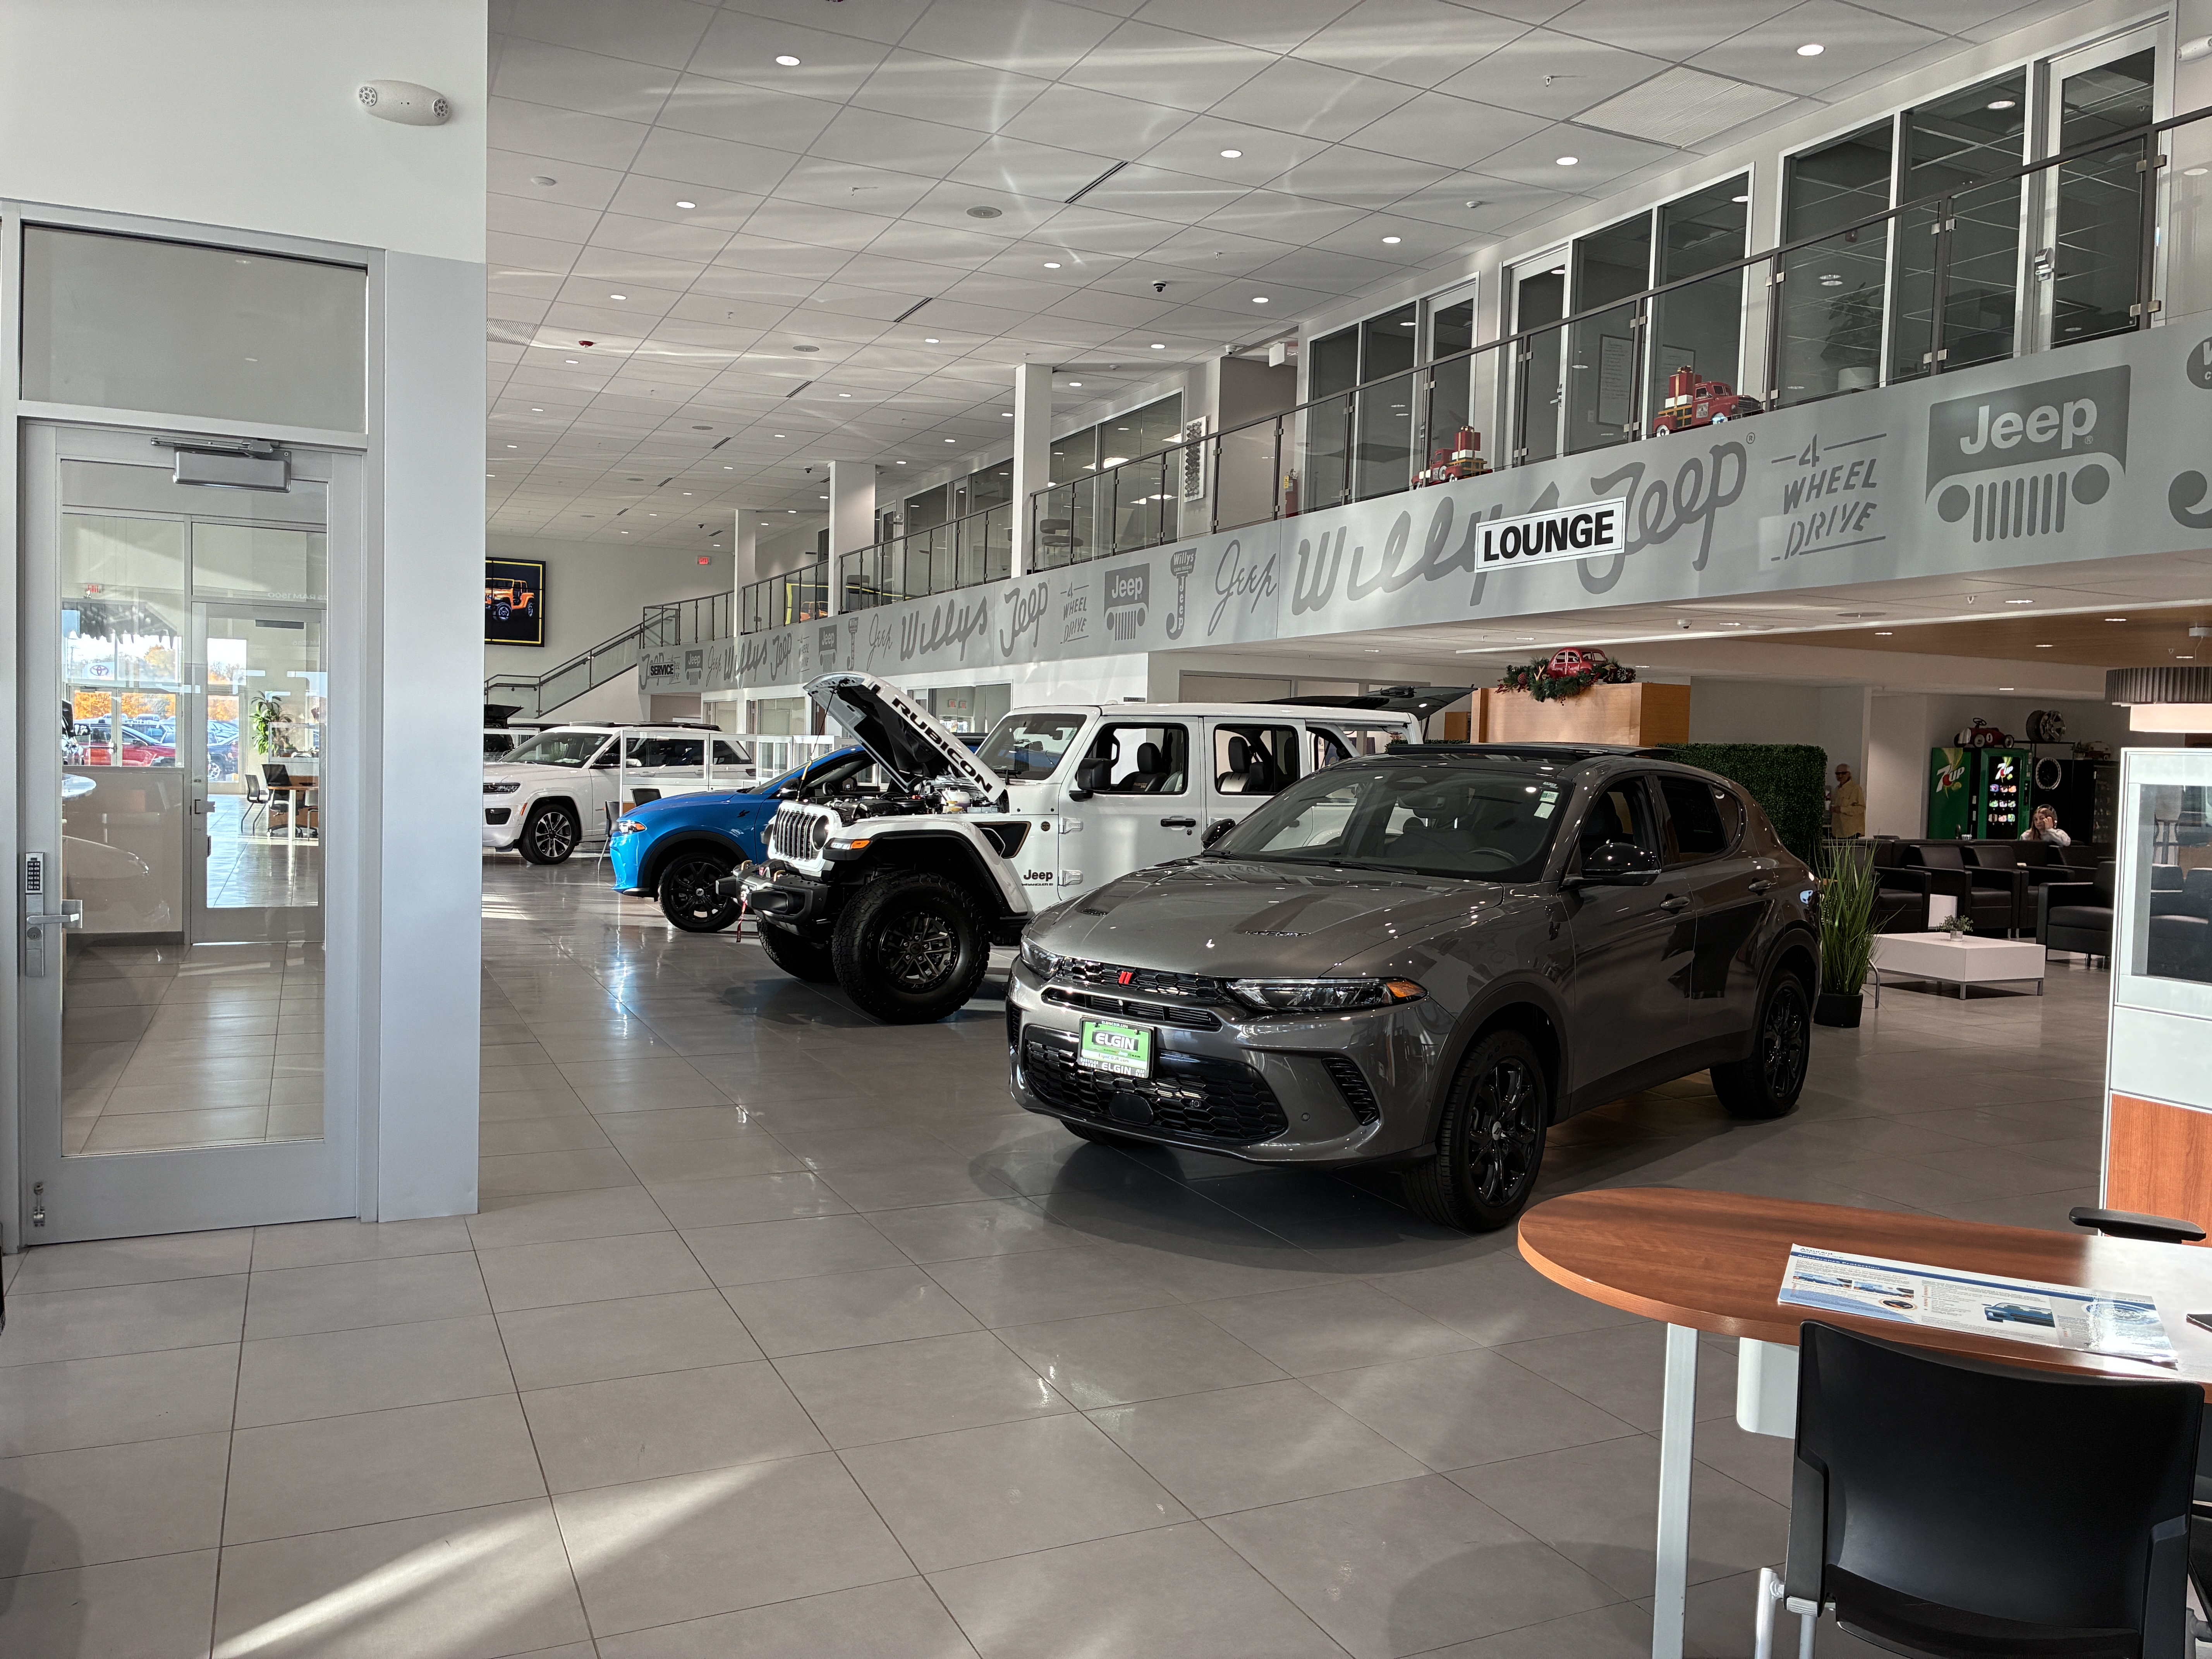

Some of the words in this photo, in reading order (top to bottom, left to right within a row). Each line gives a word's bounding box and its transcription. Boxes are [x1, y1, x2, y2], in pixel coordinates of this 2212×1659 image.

[1960, 397, 2097, 455] Jeep
[1798, 433, 1820, 468] 4
[1783, 458, 1877, 515] WHEEL
[1484, 509, 1614, 562] LOUNGE
[1784, 501, 1877, 560] DRIVE
[1174, 551, 1194, 565] Willys
[1112, 575, 1143, 600] Jeep
[1207, 539, 1277, 636] Jeep
[900, 596, 988, 661] Willys
[1000, 582, 1048, 657] Jeep
[1063, 596, 1087, 621] WHEEL
[822, 630, 835, 647] Jeep
[867, 613, 893, 672] Jeep
[1063, 617, 1087, 644] DRIVE
[650, 664, 674, 676] SERVICE
[689, 653, 701, 666] Jeep
[724, 638, 767, 682] Willys
[770, 632, 792, 681] Jeep
[891, 697, 993, 794] RUBICON
[1023, 869, 1053, 881] Jeep
[1096, 1032, 1135, 1050] ELGIN
[1102, 1062, 1132, 1075] ELGIN
[1797, 1254, 1840, 1264] Appearance
[1842, 1261, 1880, 1270] Protection
